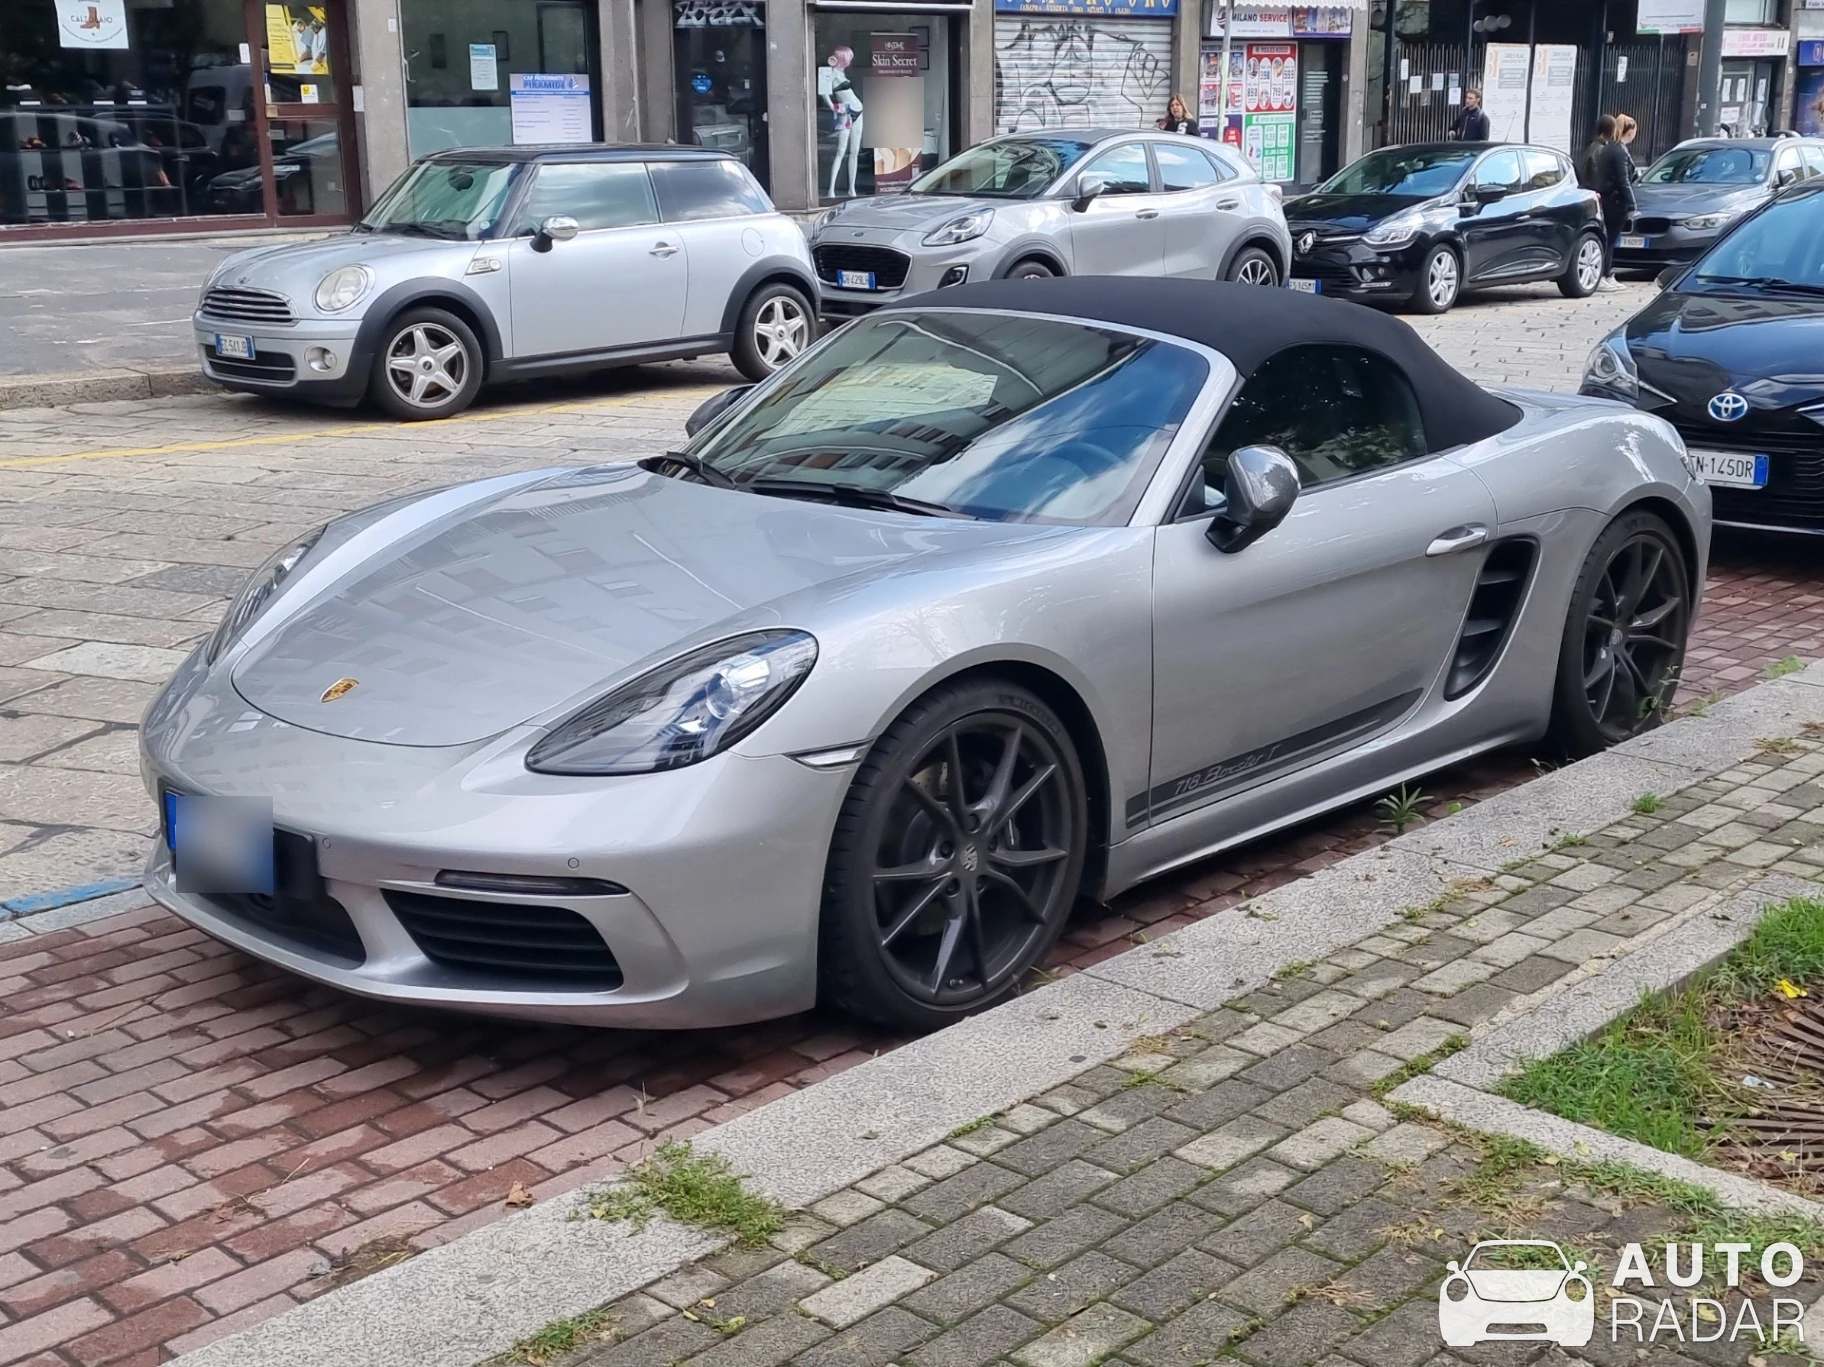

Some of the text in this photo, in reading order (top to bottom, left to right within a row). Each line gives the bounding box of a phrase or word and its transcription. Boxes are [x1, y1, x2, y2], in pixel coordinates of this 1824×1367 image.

[1231, 13, 1288, 22] MILANO SERVICE
[872, 53, 917, 67] Skin Secret
[523, 80, 566, 89] PIRAMIDE
[1175, 774, 1201, 795] 718
[1203, 755, 1264, 783] Boxster
